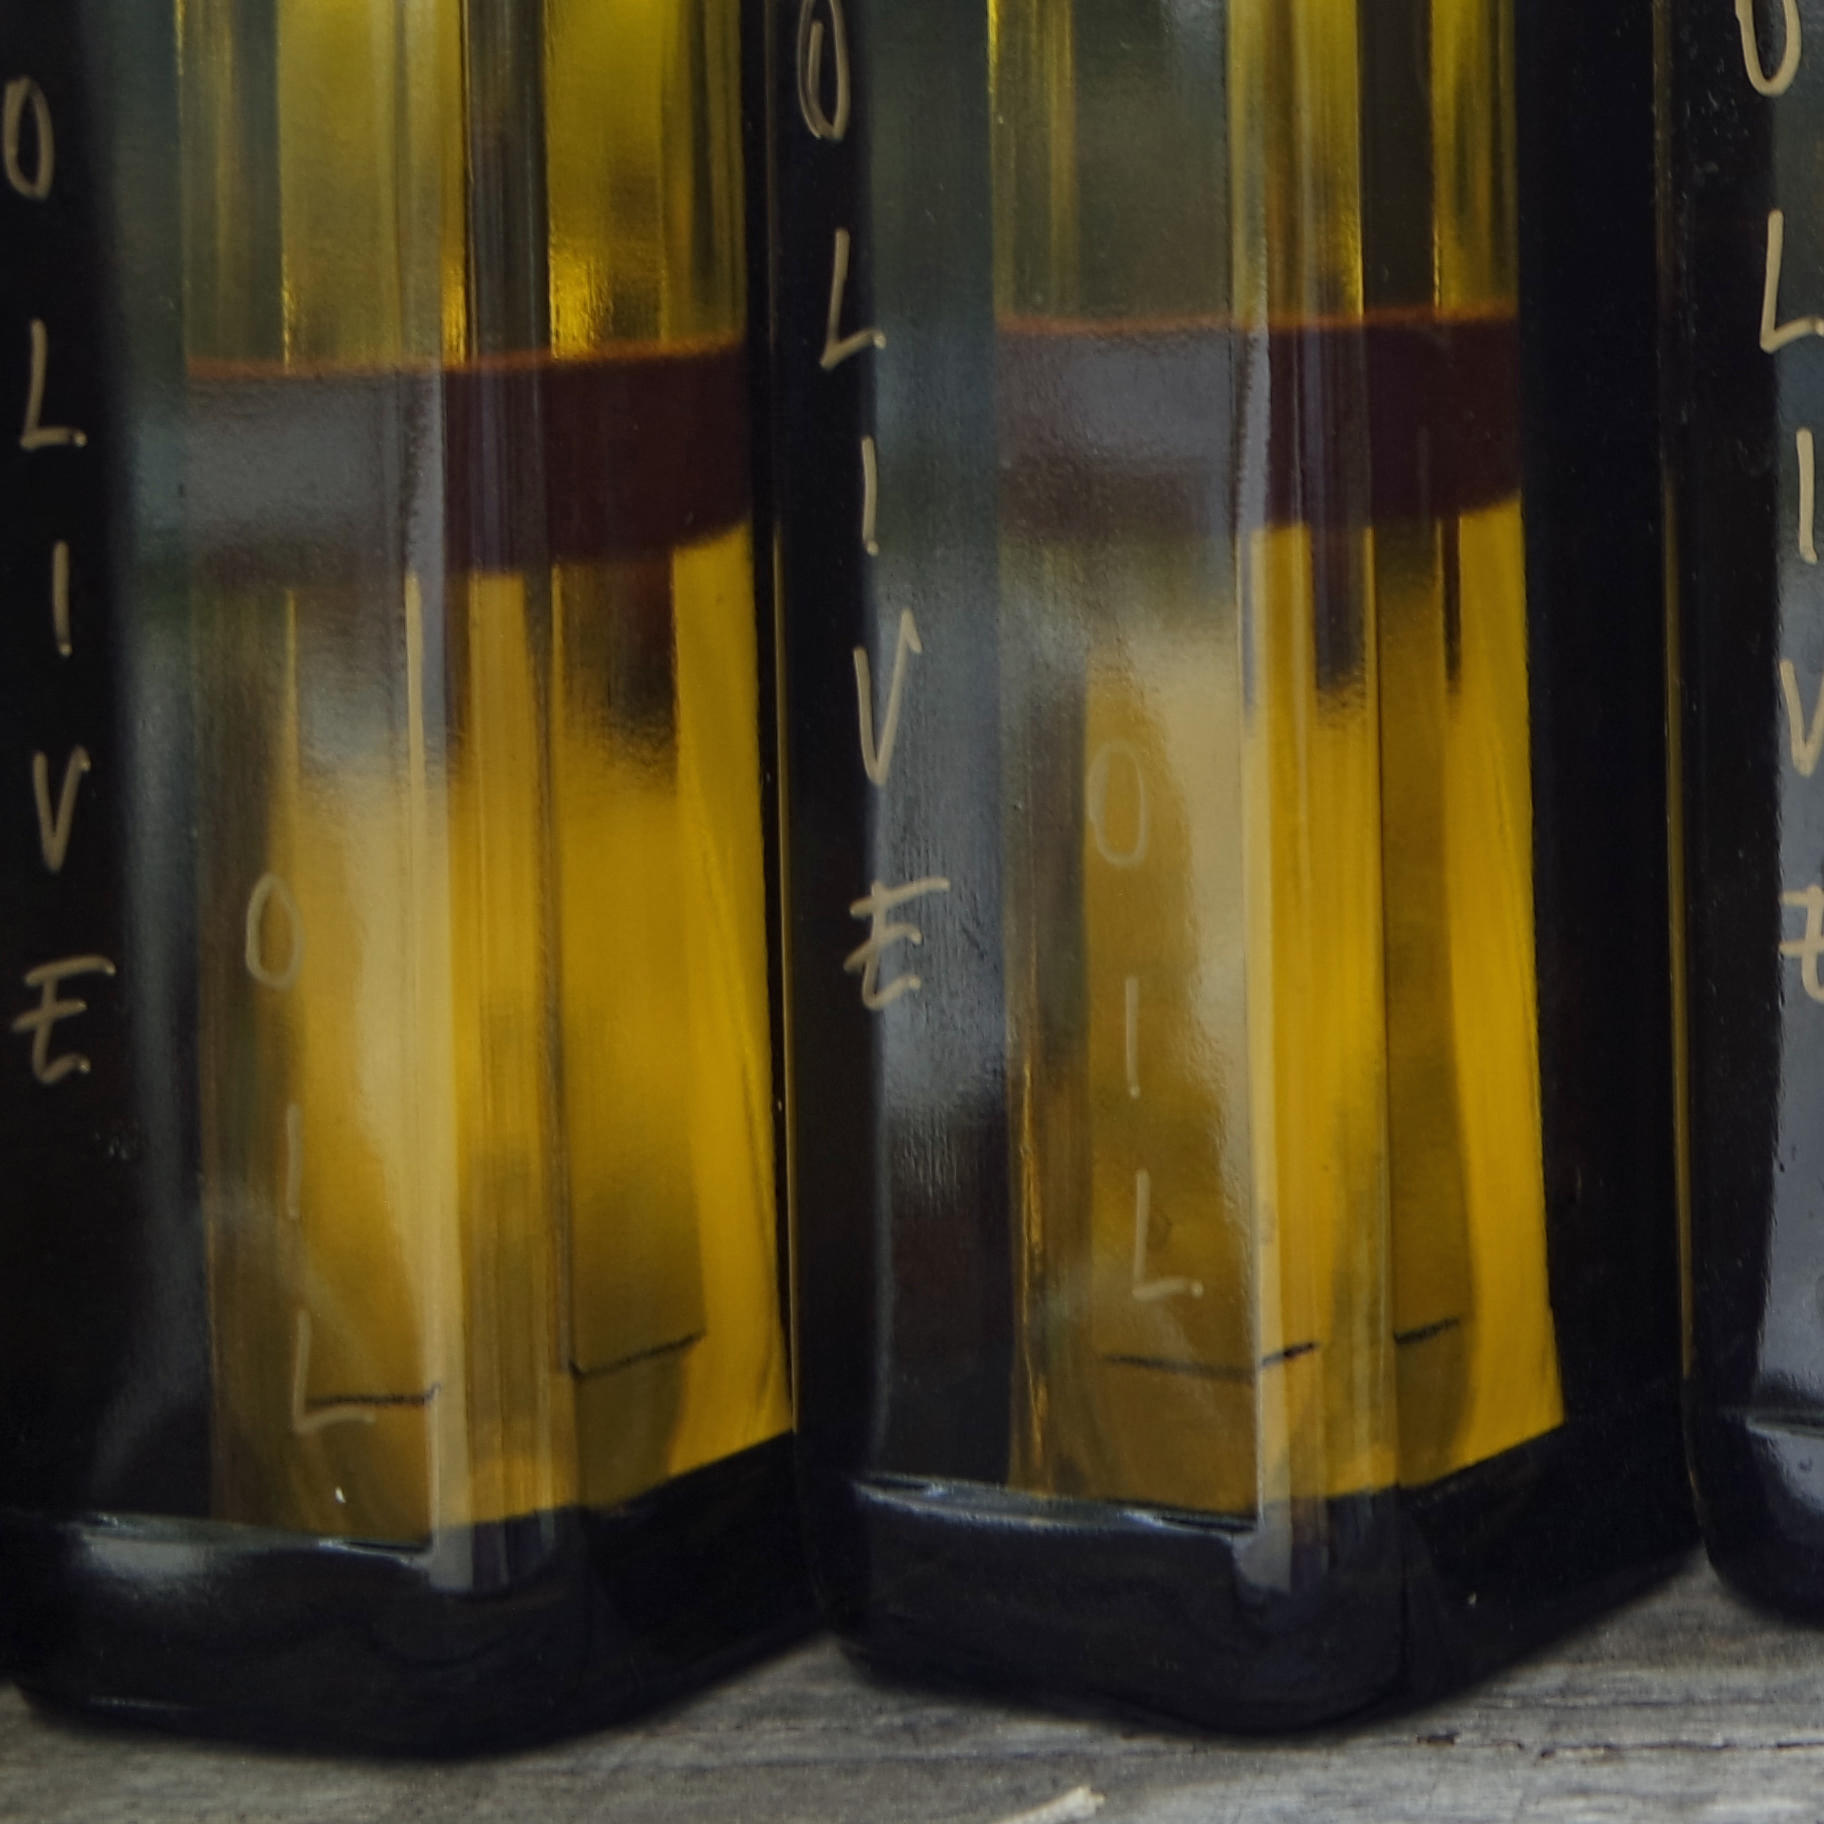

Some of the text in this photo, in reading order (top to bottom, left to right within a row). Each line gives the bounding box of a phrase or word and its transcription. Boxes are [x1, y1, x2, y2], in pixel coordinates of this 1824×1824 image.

[4, 76, 114, 1083] OLIVE
[245, 873, 375, 1431] OIL
[1087, 739, 1203, 1301] OIL
